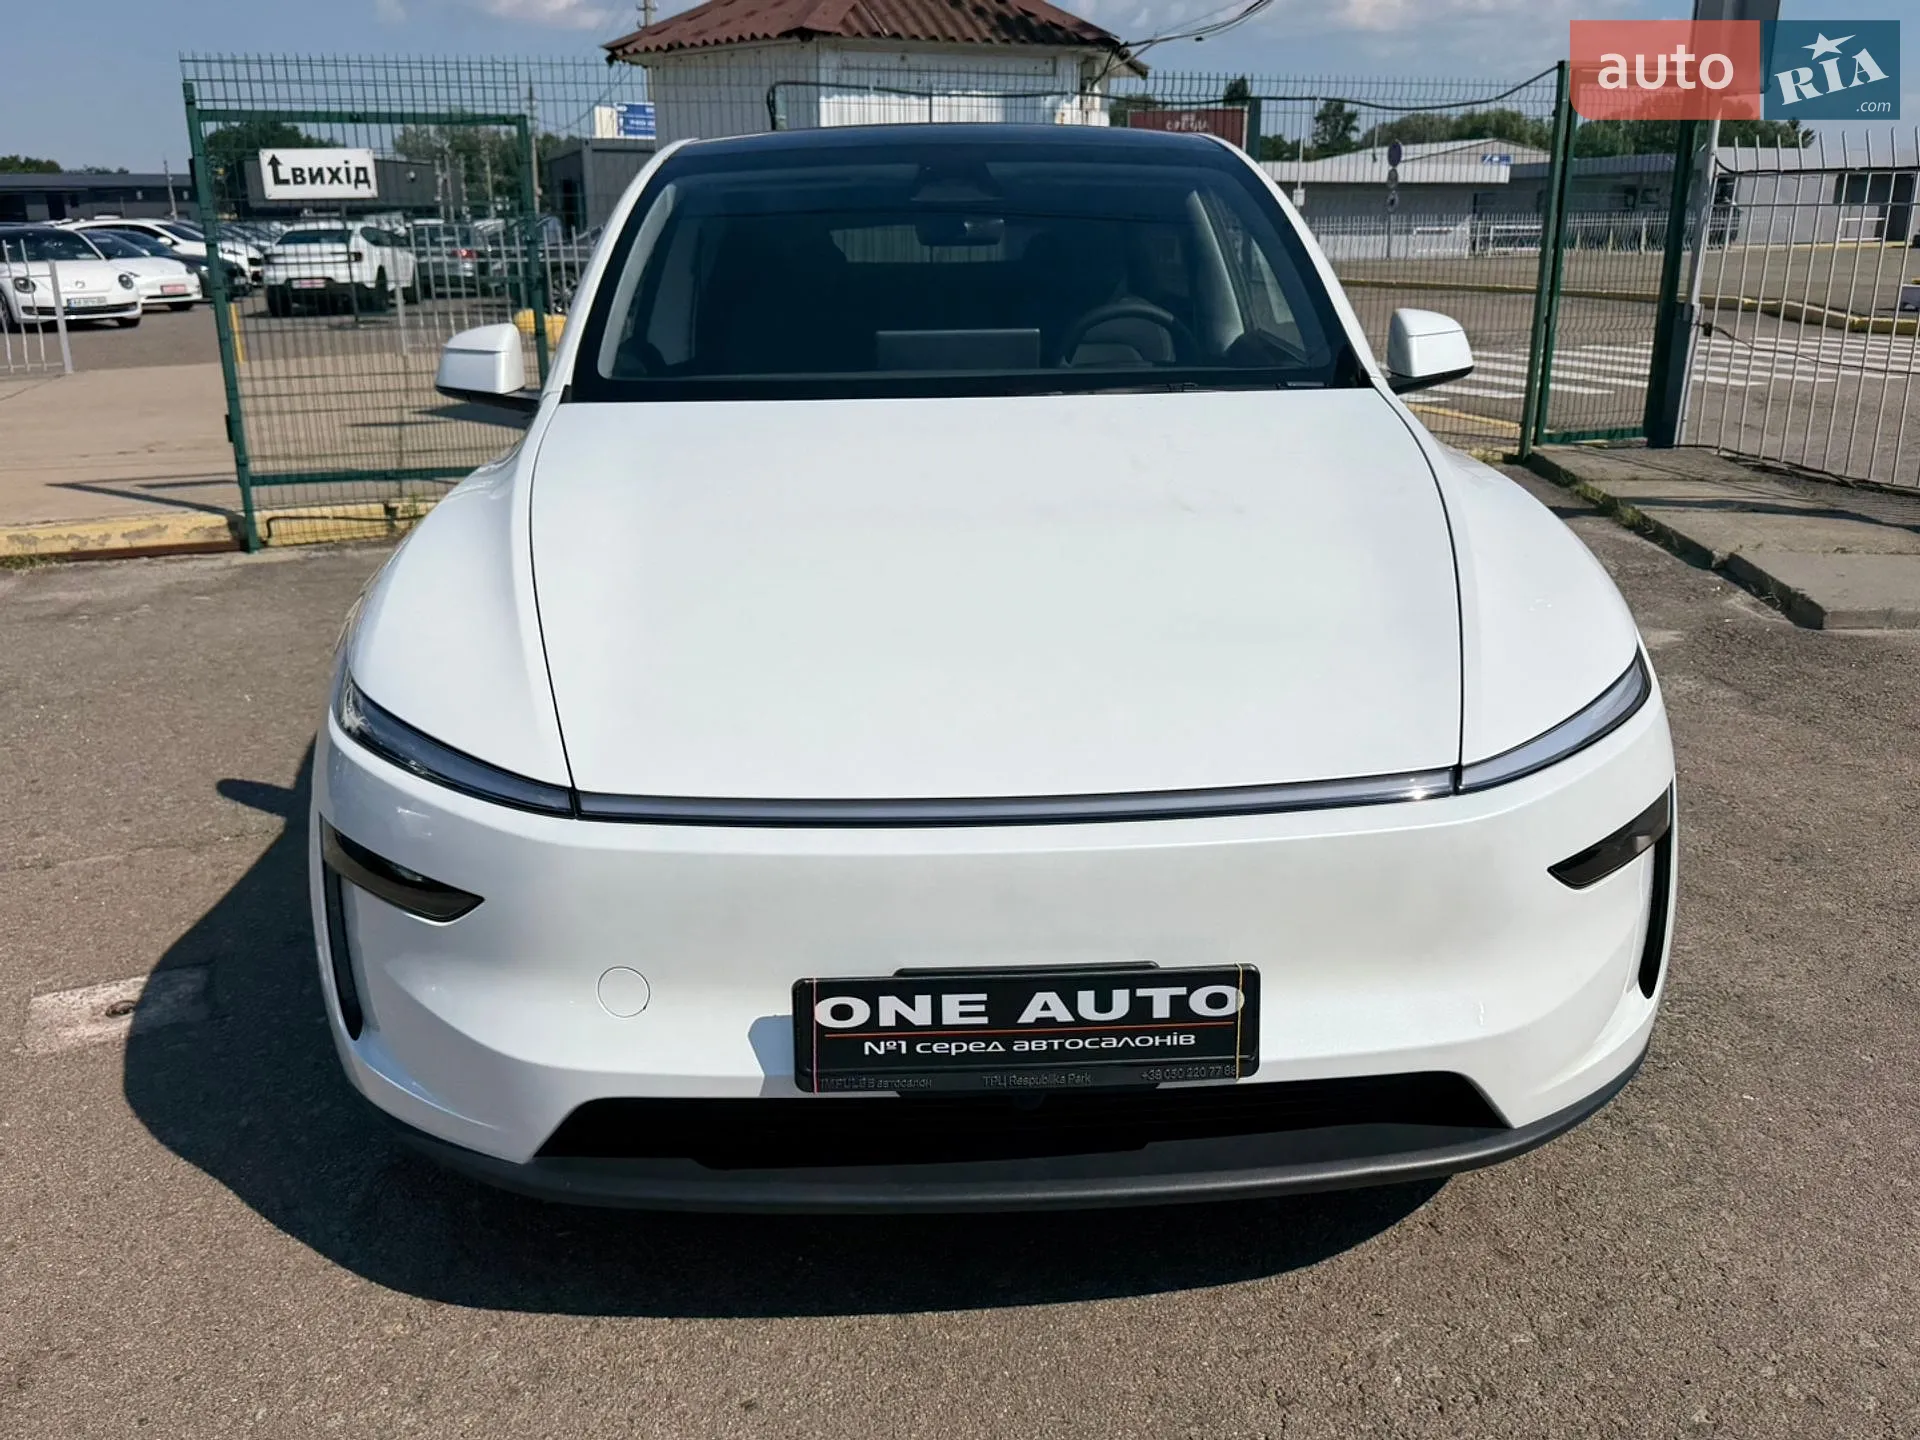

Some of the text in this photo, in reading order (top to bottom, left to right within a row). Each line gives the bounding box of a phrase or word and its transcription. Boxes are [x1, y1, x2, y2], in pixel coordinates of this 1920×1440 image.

[291, 160, 371, 189] вихід
[815, 985, 1245, 1028] ONE AUTO
[915, 1041, 1006, 1056] серед
[1013, 1032, 1196, 1052] автосалонів
